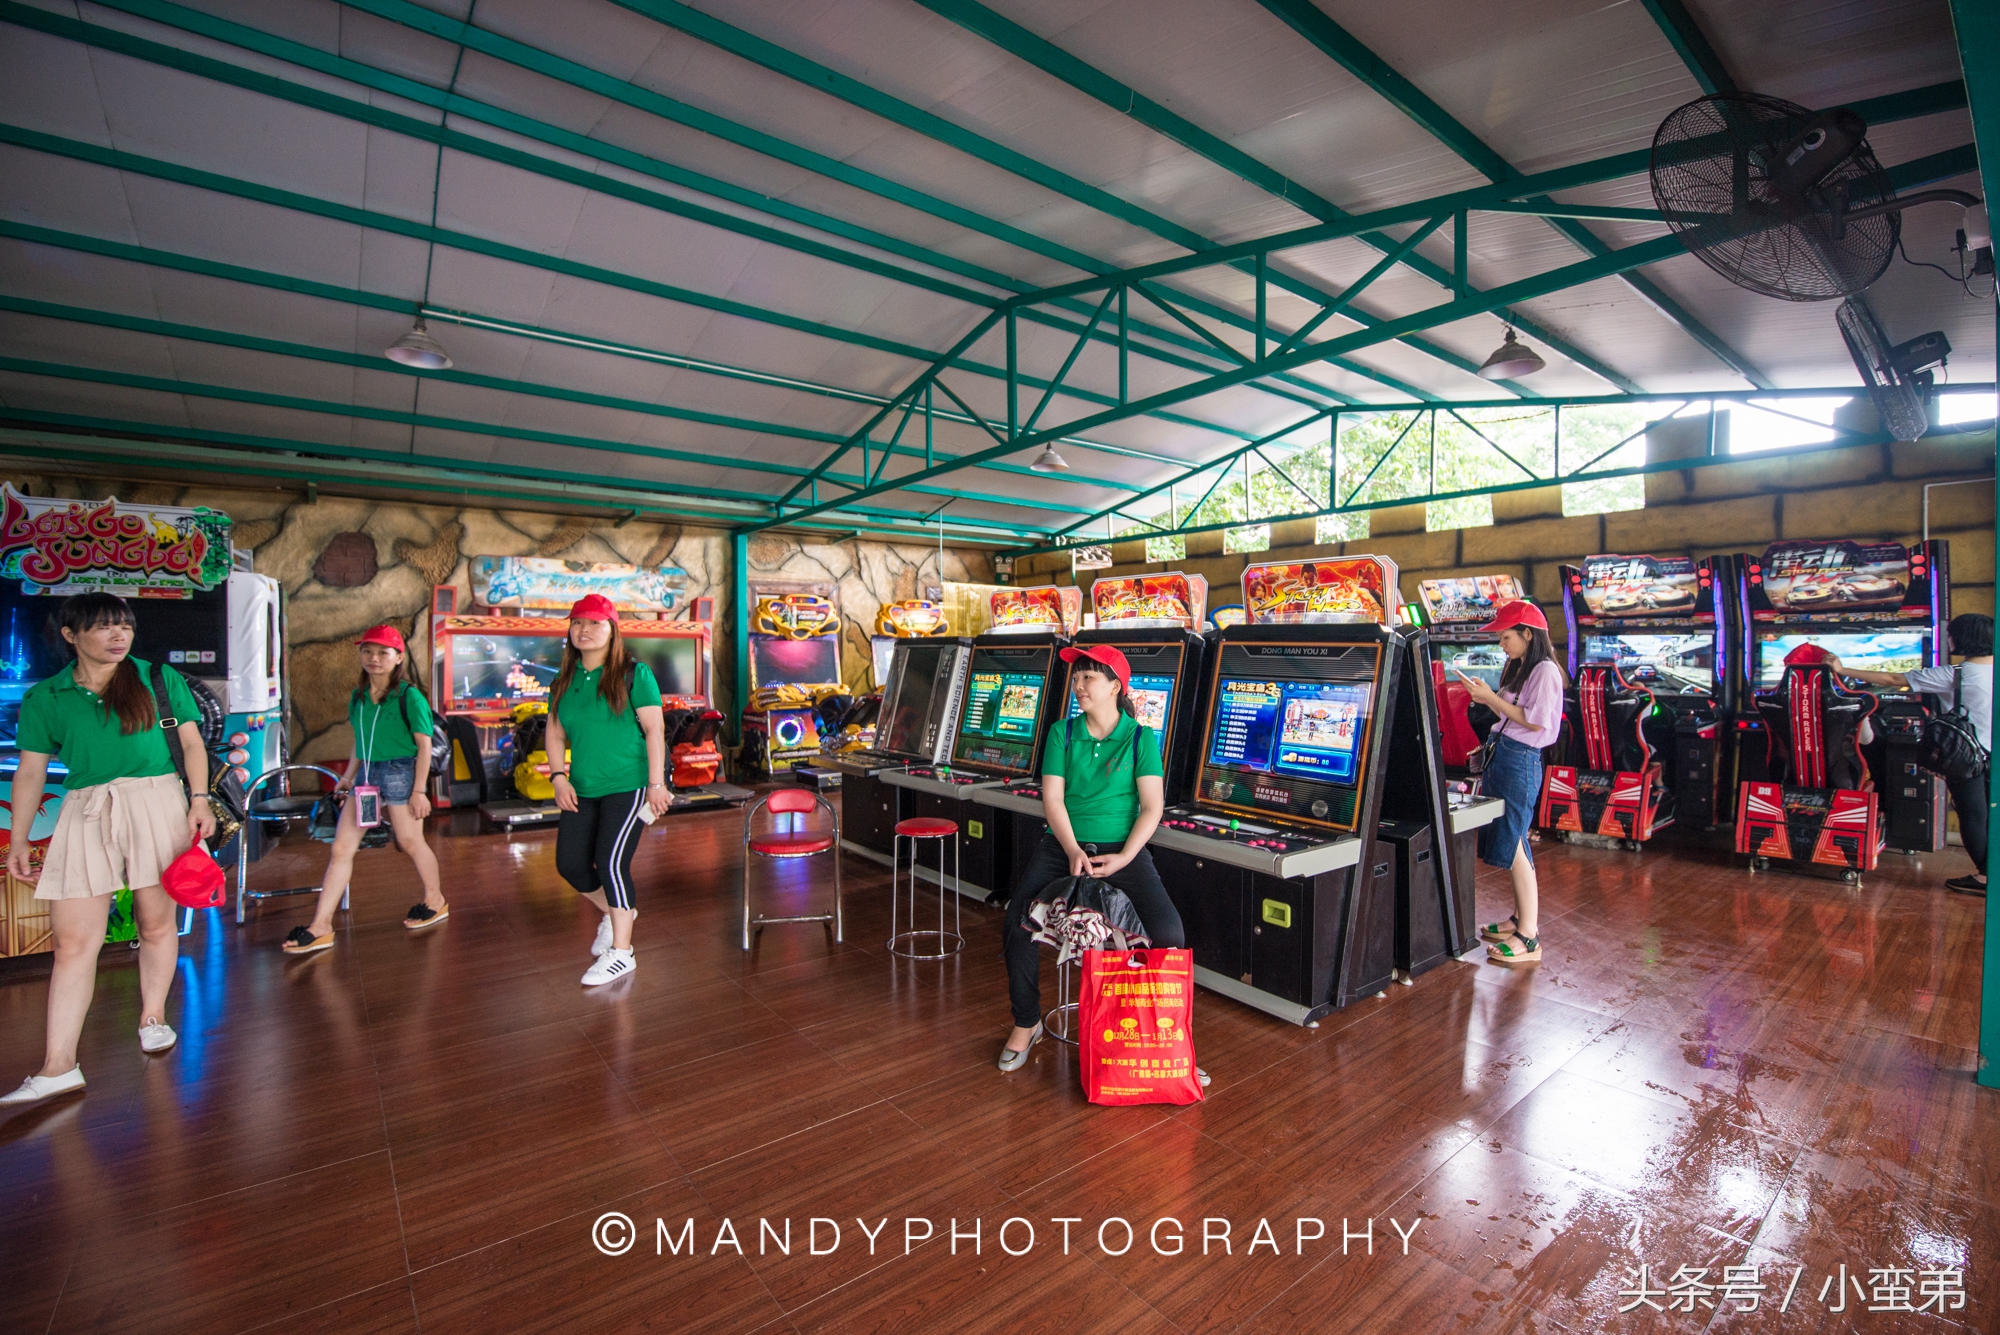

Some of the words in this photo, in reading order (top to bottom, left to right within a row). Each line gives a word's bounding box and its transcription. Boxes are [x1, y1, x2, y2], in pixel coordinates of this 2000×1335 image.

[87, 499, 146, 538] GO
[20, 526, 207, 582] JUNGLE!
[1255, 580, 1339, 612] STREET
[1261, 647, 1282, 655] DONG
[957, 654, 969, 682] EARTH
[950, 685, 963, 720] SCIENCE
[1802, 685, 1810, 719] STORM
[945, 723, 954, 741] AND
[1803, 721, 1812, 751] RACER
[940, 745, 950, 763] TEC
